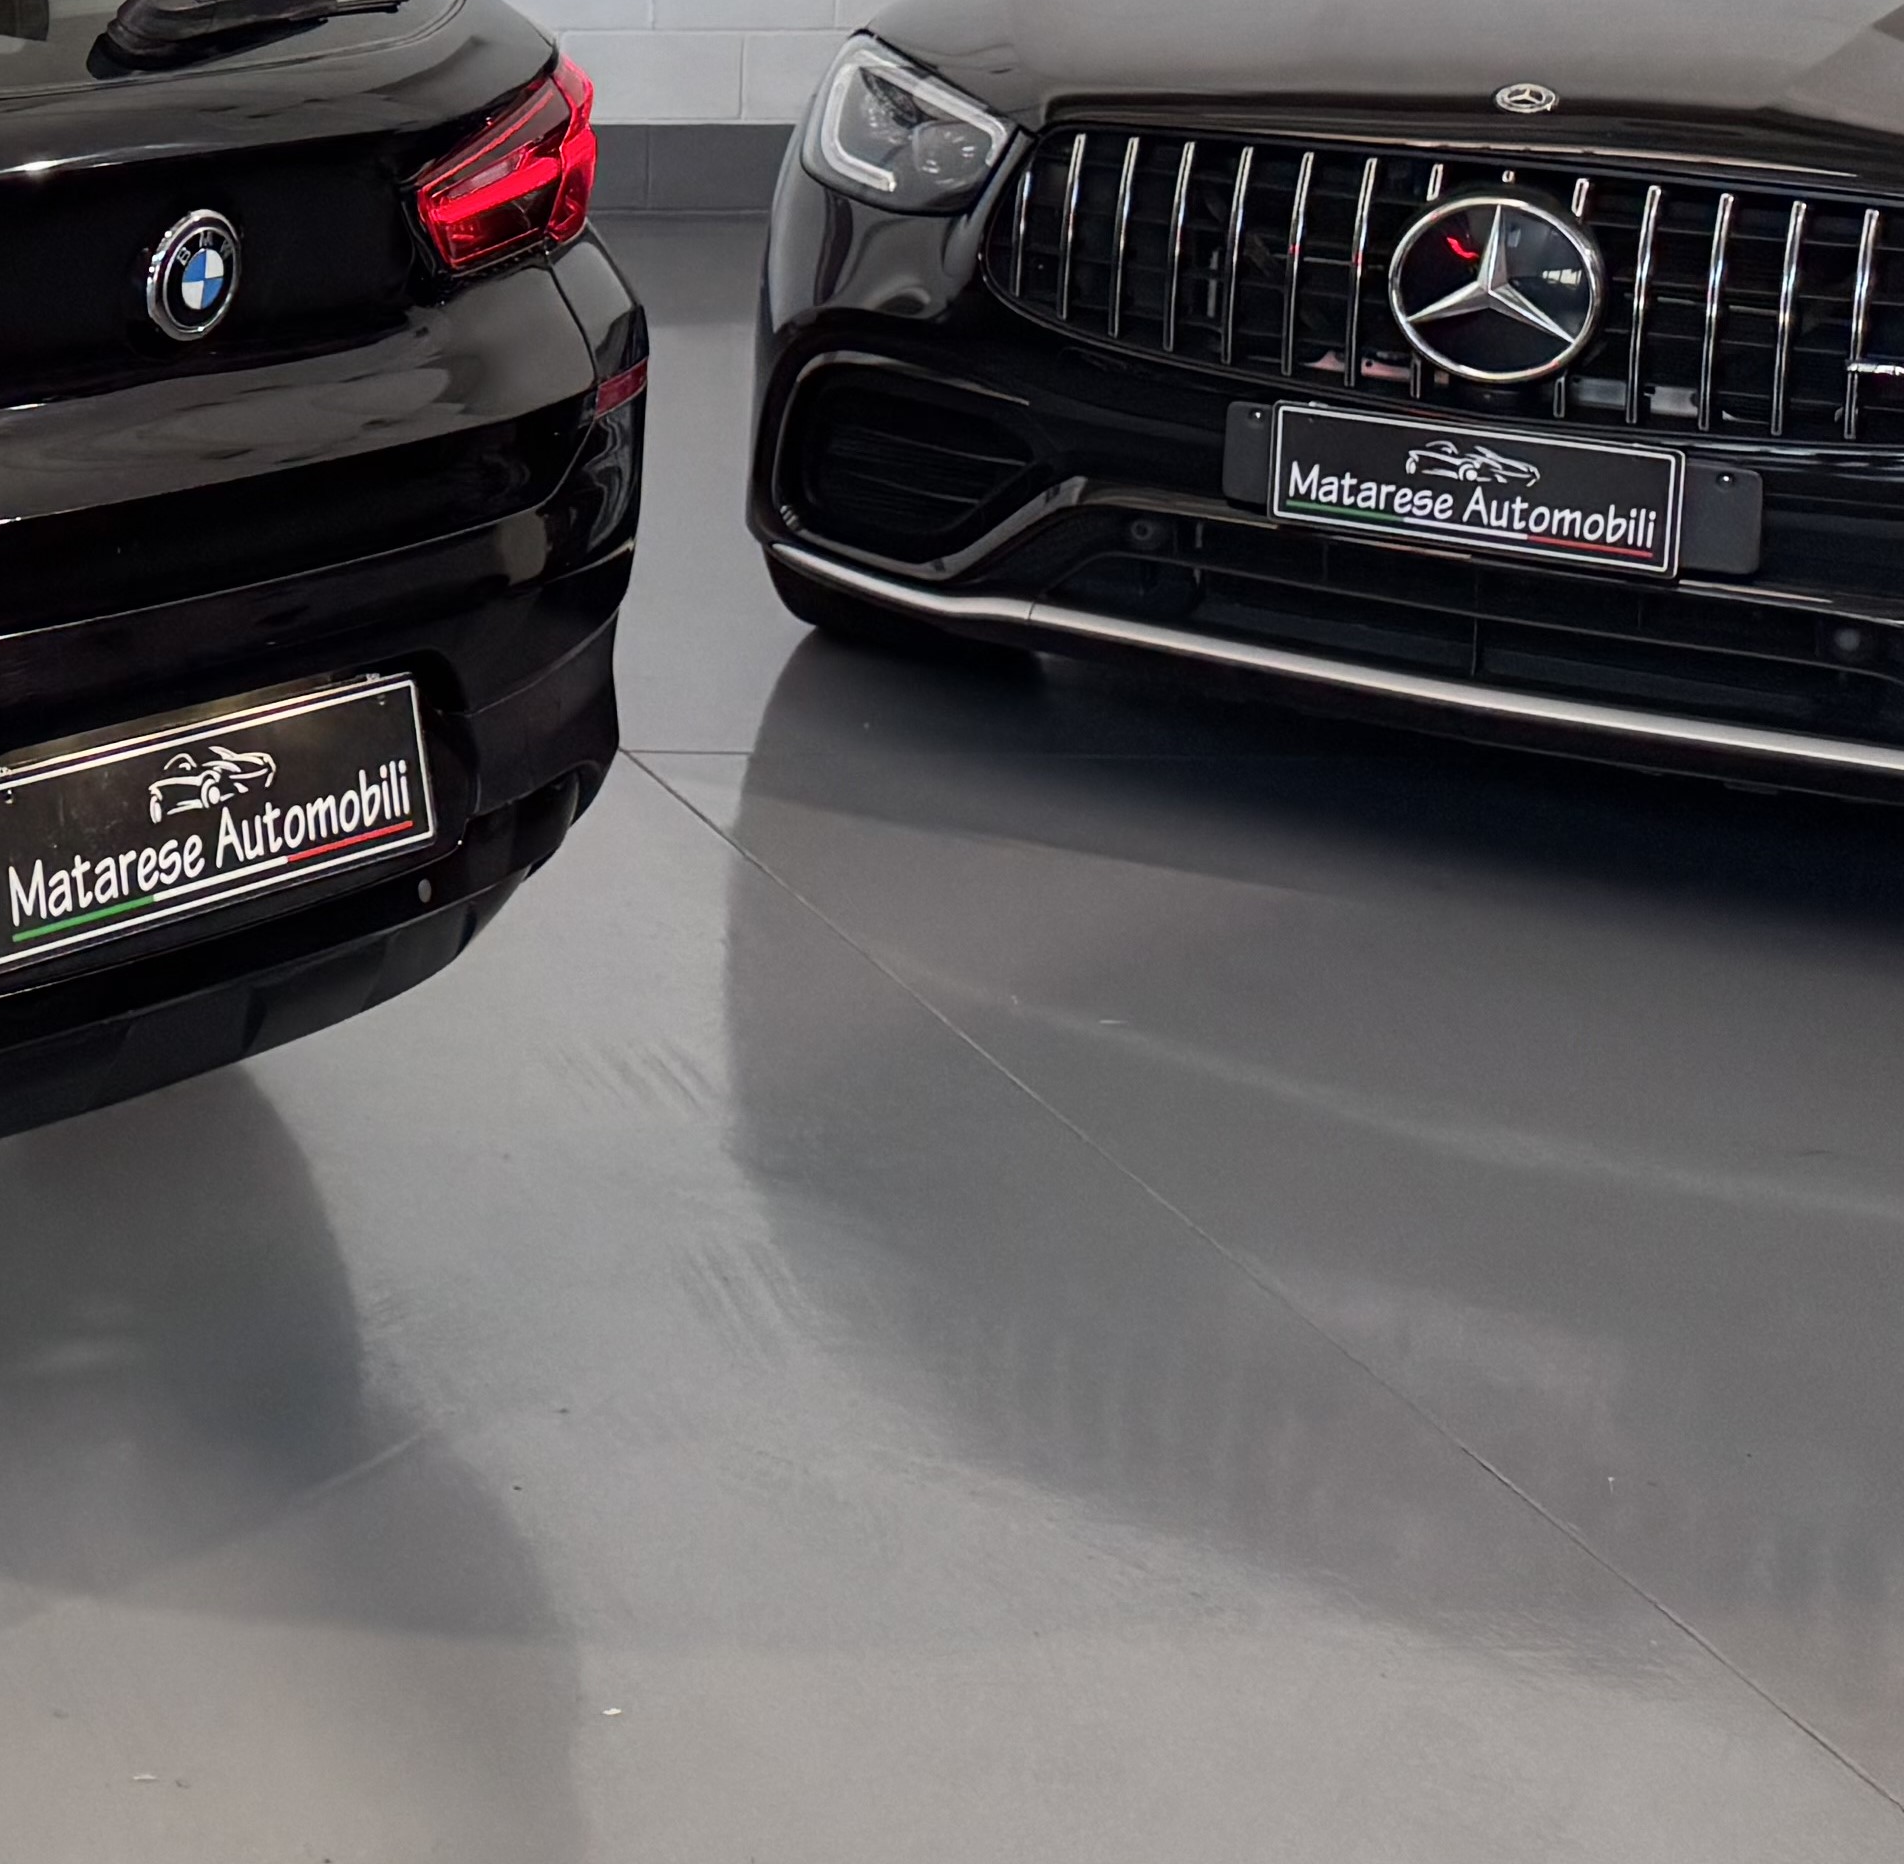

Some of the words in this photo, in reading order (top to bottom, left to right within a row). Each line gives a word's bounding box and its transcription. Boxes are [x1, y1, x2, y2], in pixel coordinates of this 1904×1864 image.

[177, 230, 234, 266] BMW
[1288, 460, 1454, 520] Matarese
[1462, 485, 1657, 549] Automobili
[8, 834, 206, 927] Matarese
[215, 759, 411, 869] Automobili
